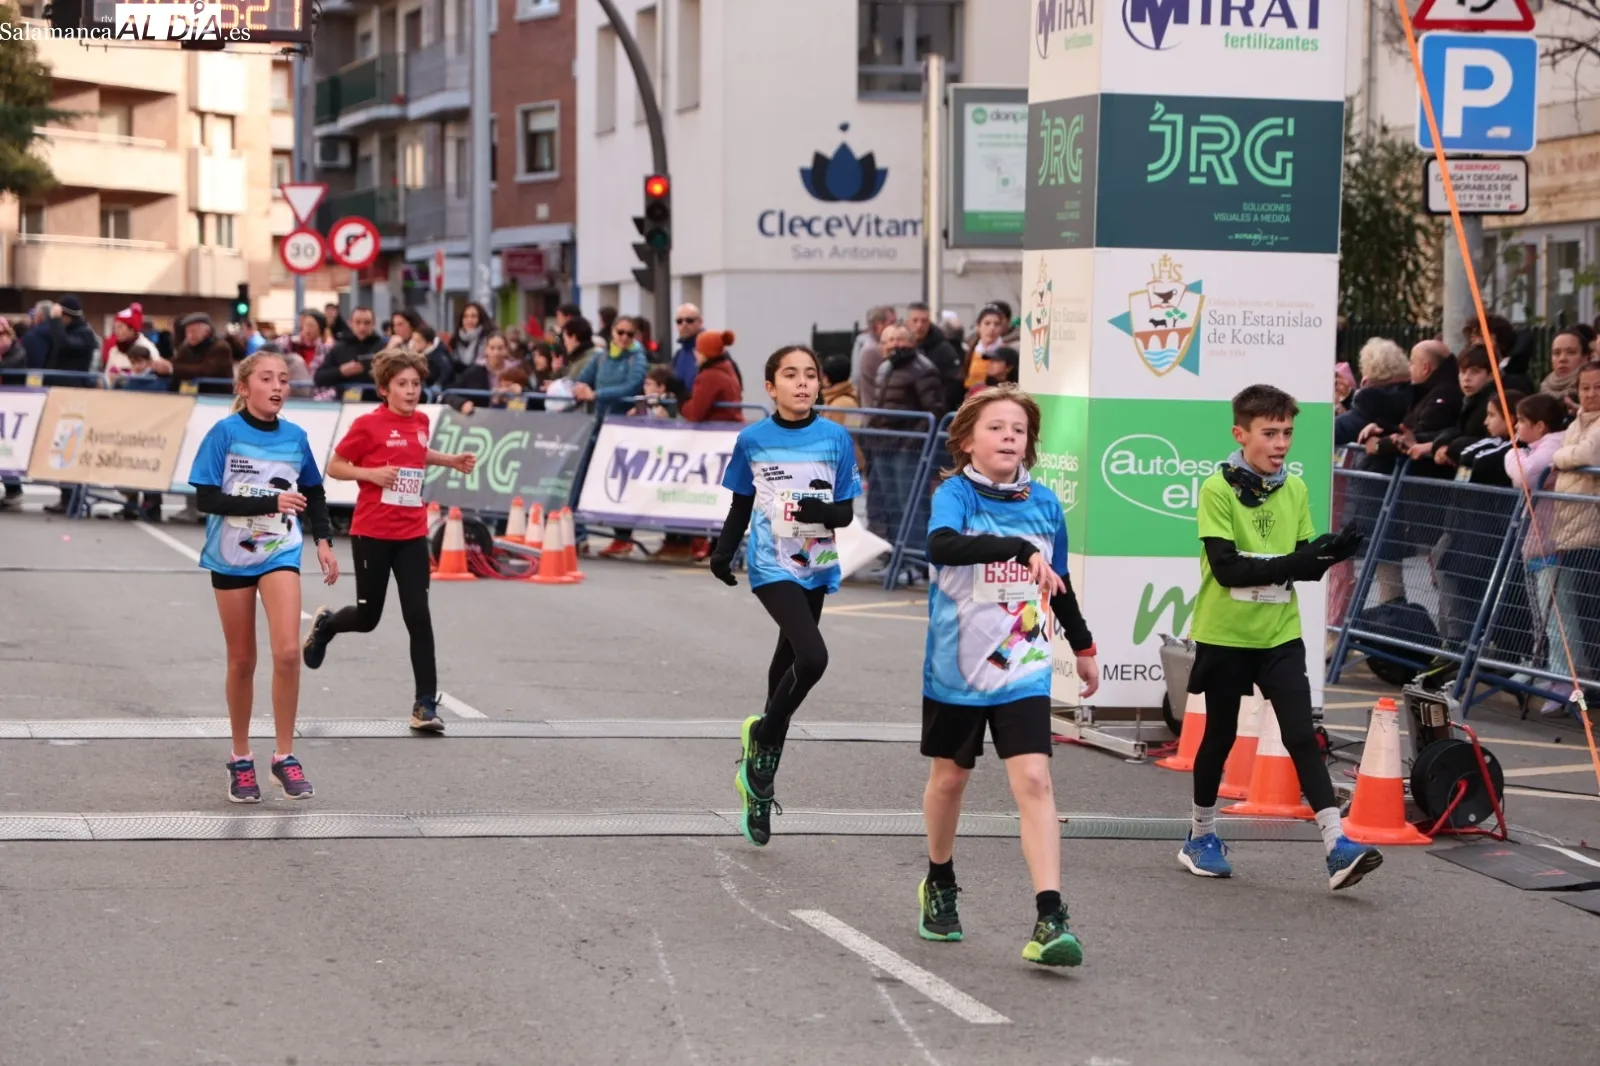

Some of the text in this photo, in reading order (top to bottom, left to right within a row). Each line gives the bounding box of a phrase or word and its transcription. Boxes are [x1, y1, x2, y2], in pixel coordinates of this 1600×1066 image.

[1224, 32, 1319, 51] fertilizantes
[1443, 47, 1514, 138] P
[1038, 110, 1084, 186] JRG
[1147, 104, 1295, 187] JRG
[1242, 202, 1292, 213] SOLUCIONES
[1213, 212, 1291, 223] VISUALES A MEDIDA
[290, 242, 316, 260] 30
[791, 245, 898, 261] San Antonio
[1208, 309, 1322, 328] San Estanislao
[1207, 328, 1285, 345] de Kostka
[85, 428, 167, 449] Ayuntamiento
[79, 452, 161, 472] de Salamanca
[1162, 477, 1198, 508] el
[1103, 664, 1166, 681] MERC
